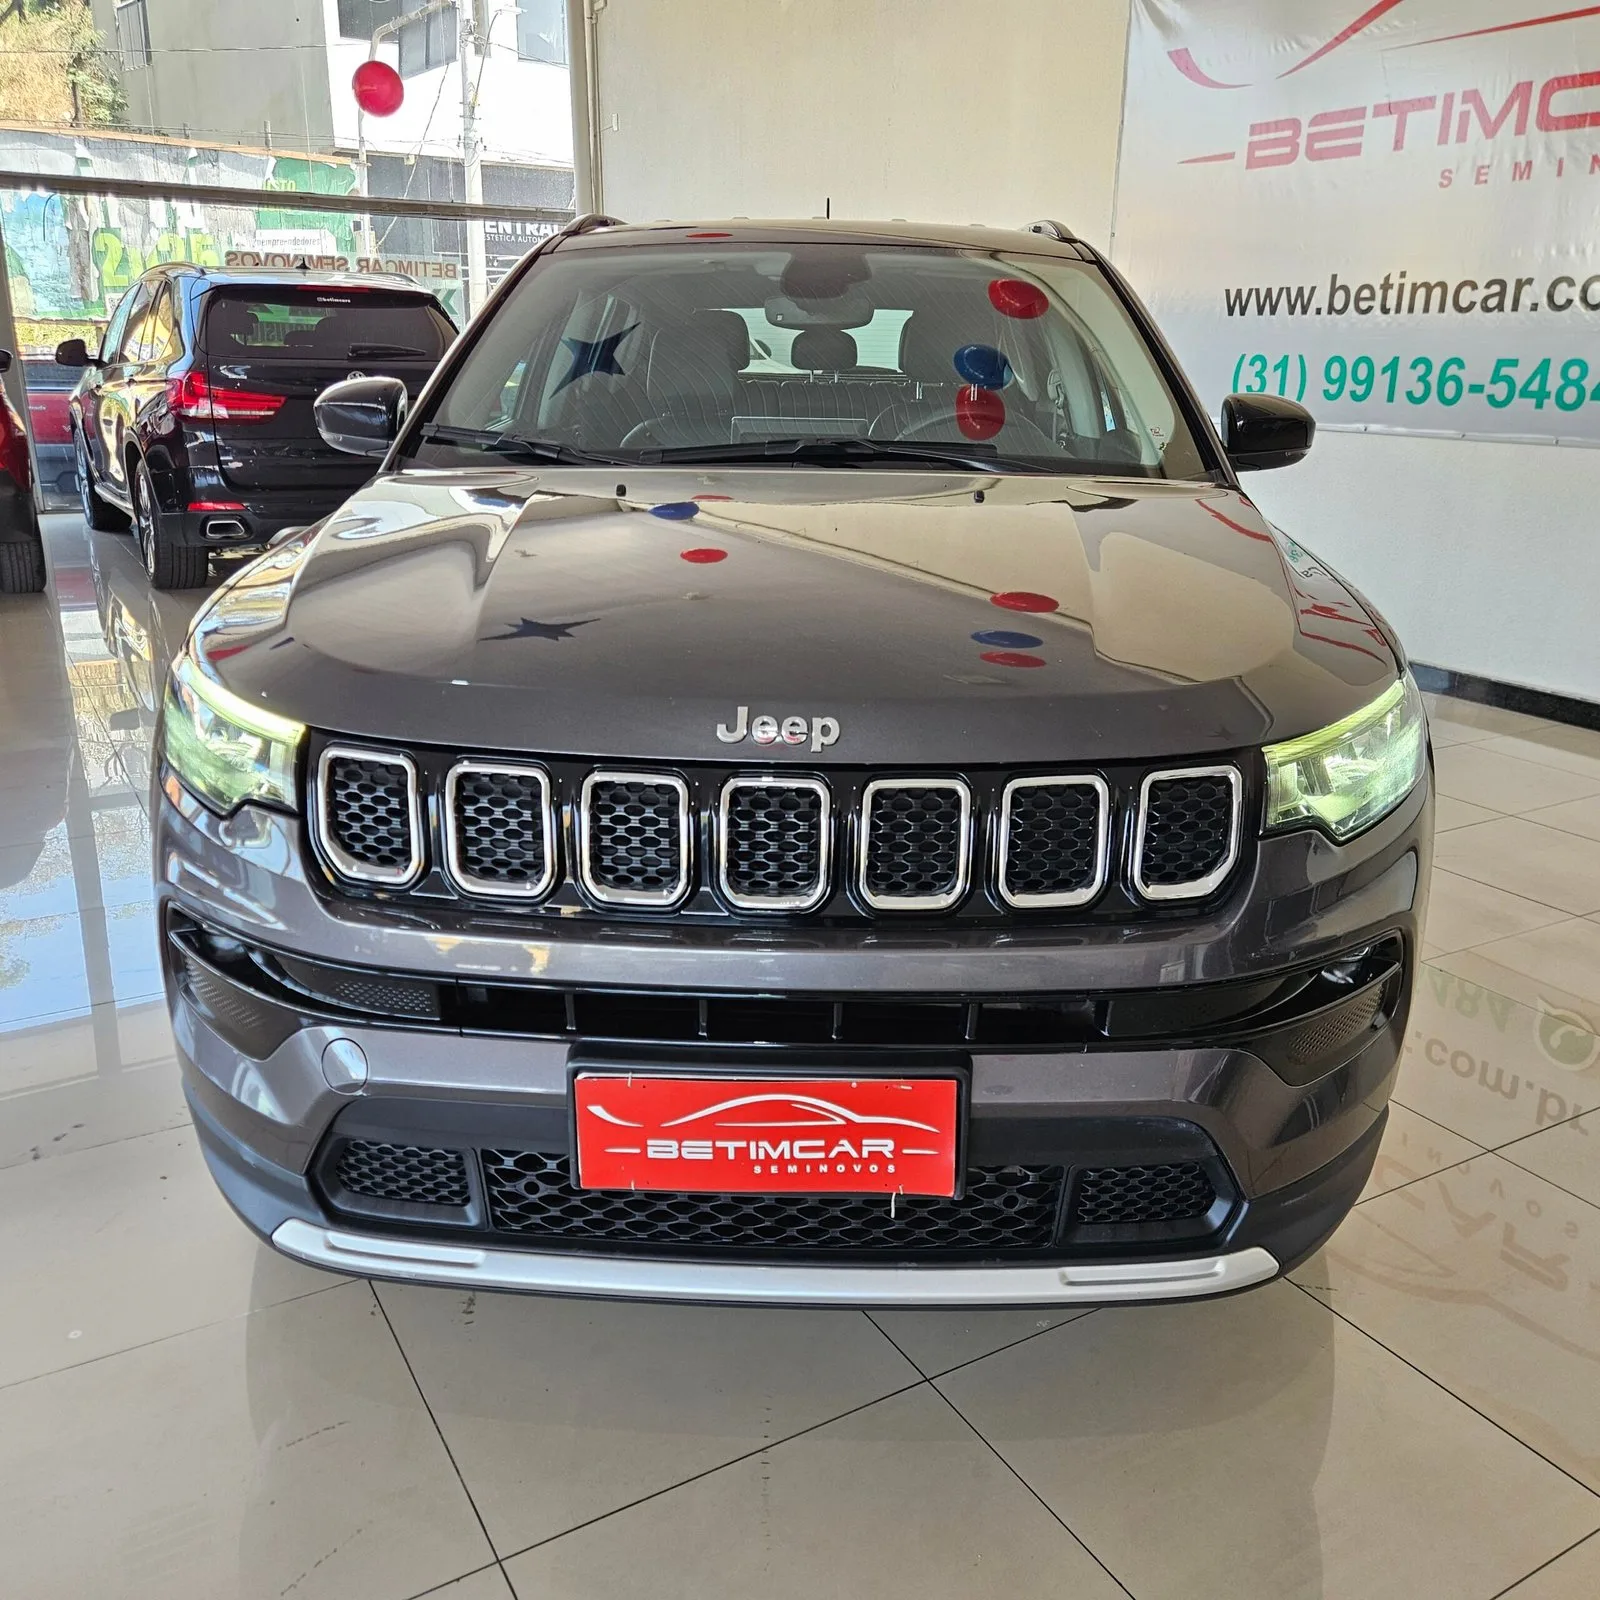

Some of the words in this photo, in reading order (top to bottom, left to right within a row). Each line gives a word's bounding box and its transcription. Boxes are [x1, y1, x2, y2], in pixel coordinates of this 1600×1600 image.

[1245, 71, 1600, 170] BETIMC
[1224, 271, 1600, 317] www.betimcar.co
[1232, 353, 1307, 402] (31)
[716, 706, 841, 753] Jeep
[646, 1139, 895, 1160] BETIMCAR
[753, 1164, 896, 1175] SEMINOVOS
